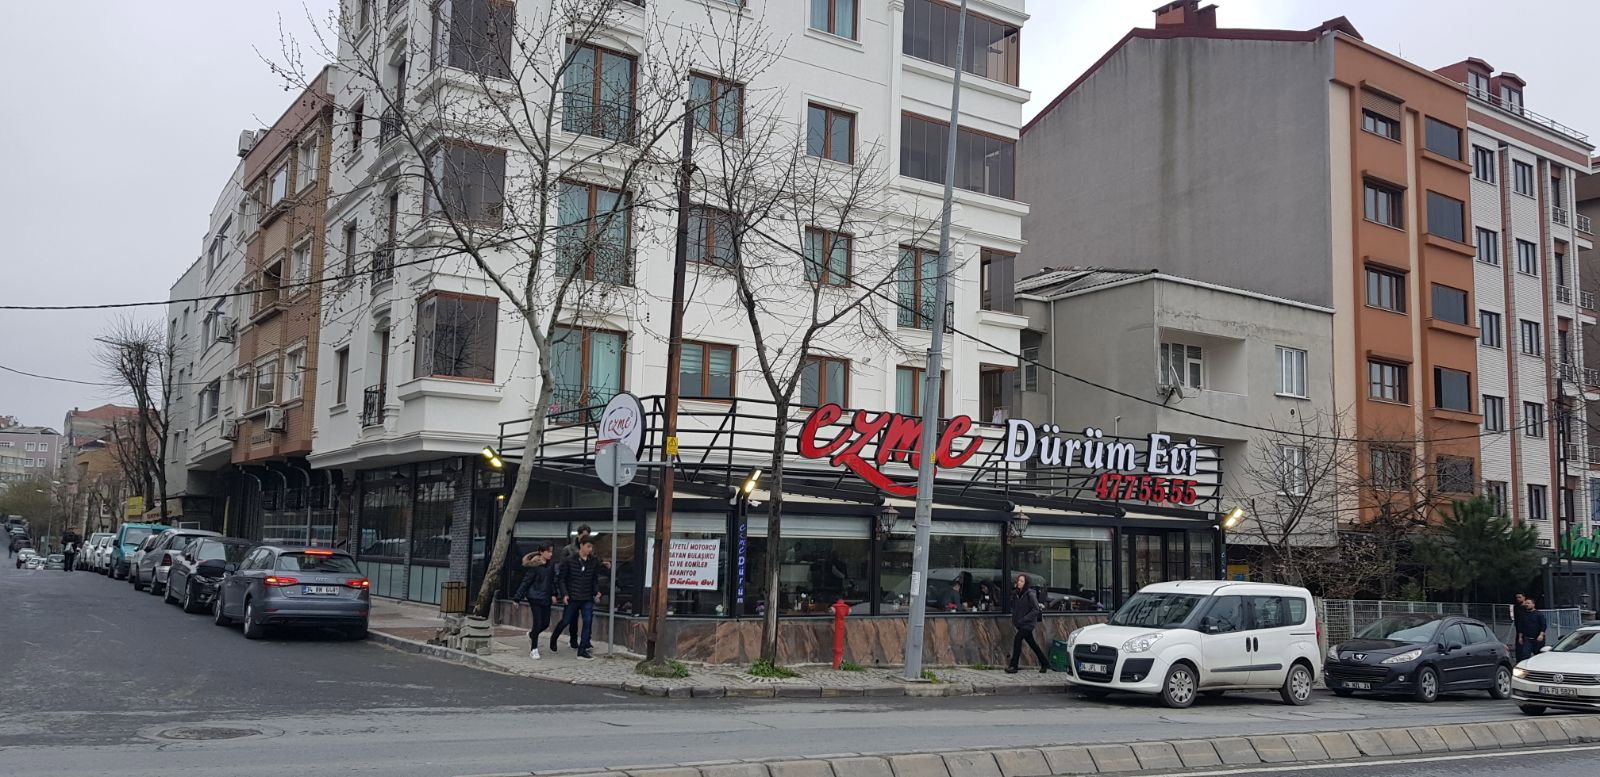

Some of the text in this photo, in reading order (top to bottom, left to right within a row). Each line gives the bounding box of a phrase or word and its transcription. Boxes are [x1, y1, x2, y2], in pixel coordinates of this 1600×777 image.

[798, 403, 1198, 497] ezme Dürüm Evi
[690, 543, 717, 551] MOTORCU
